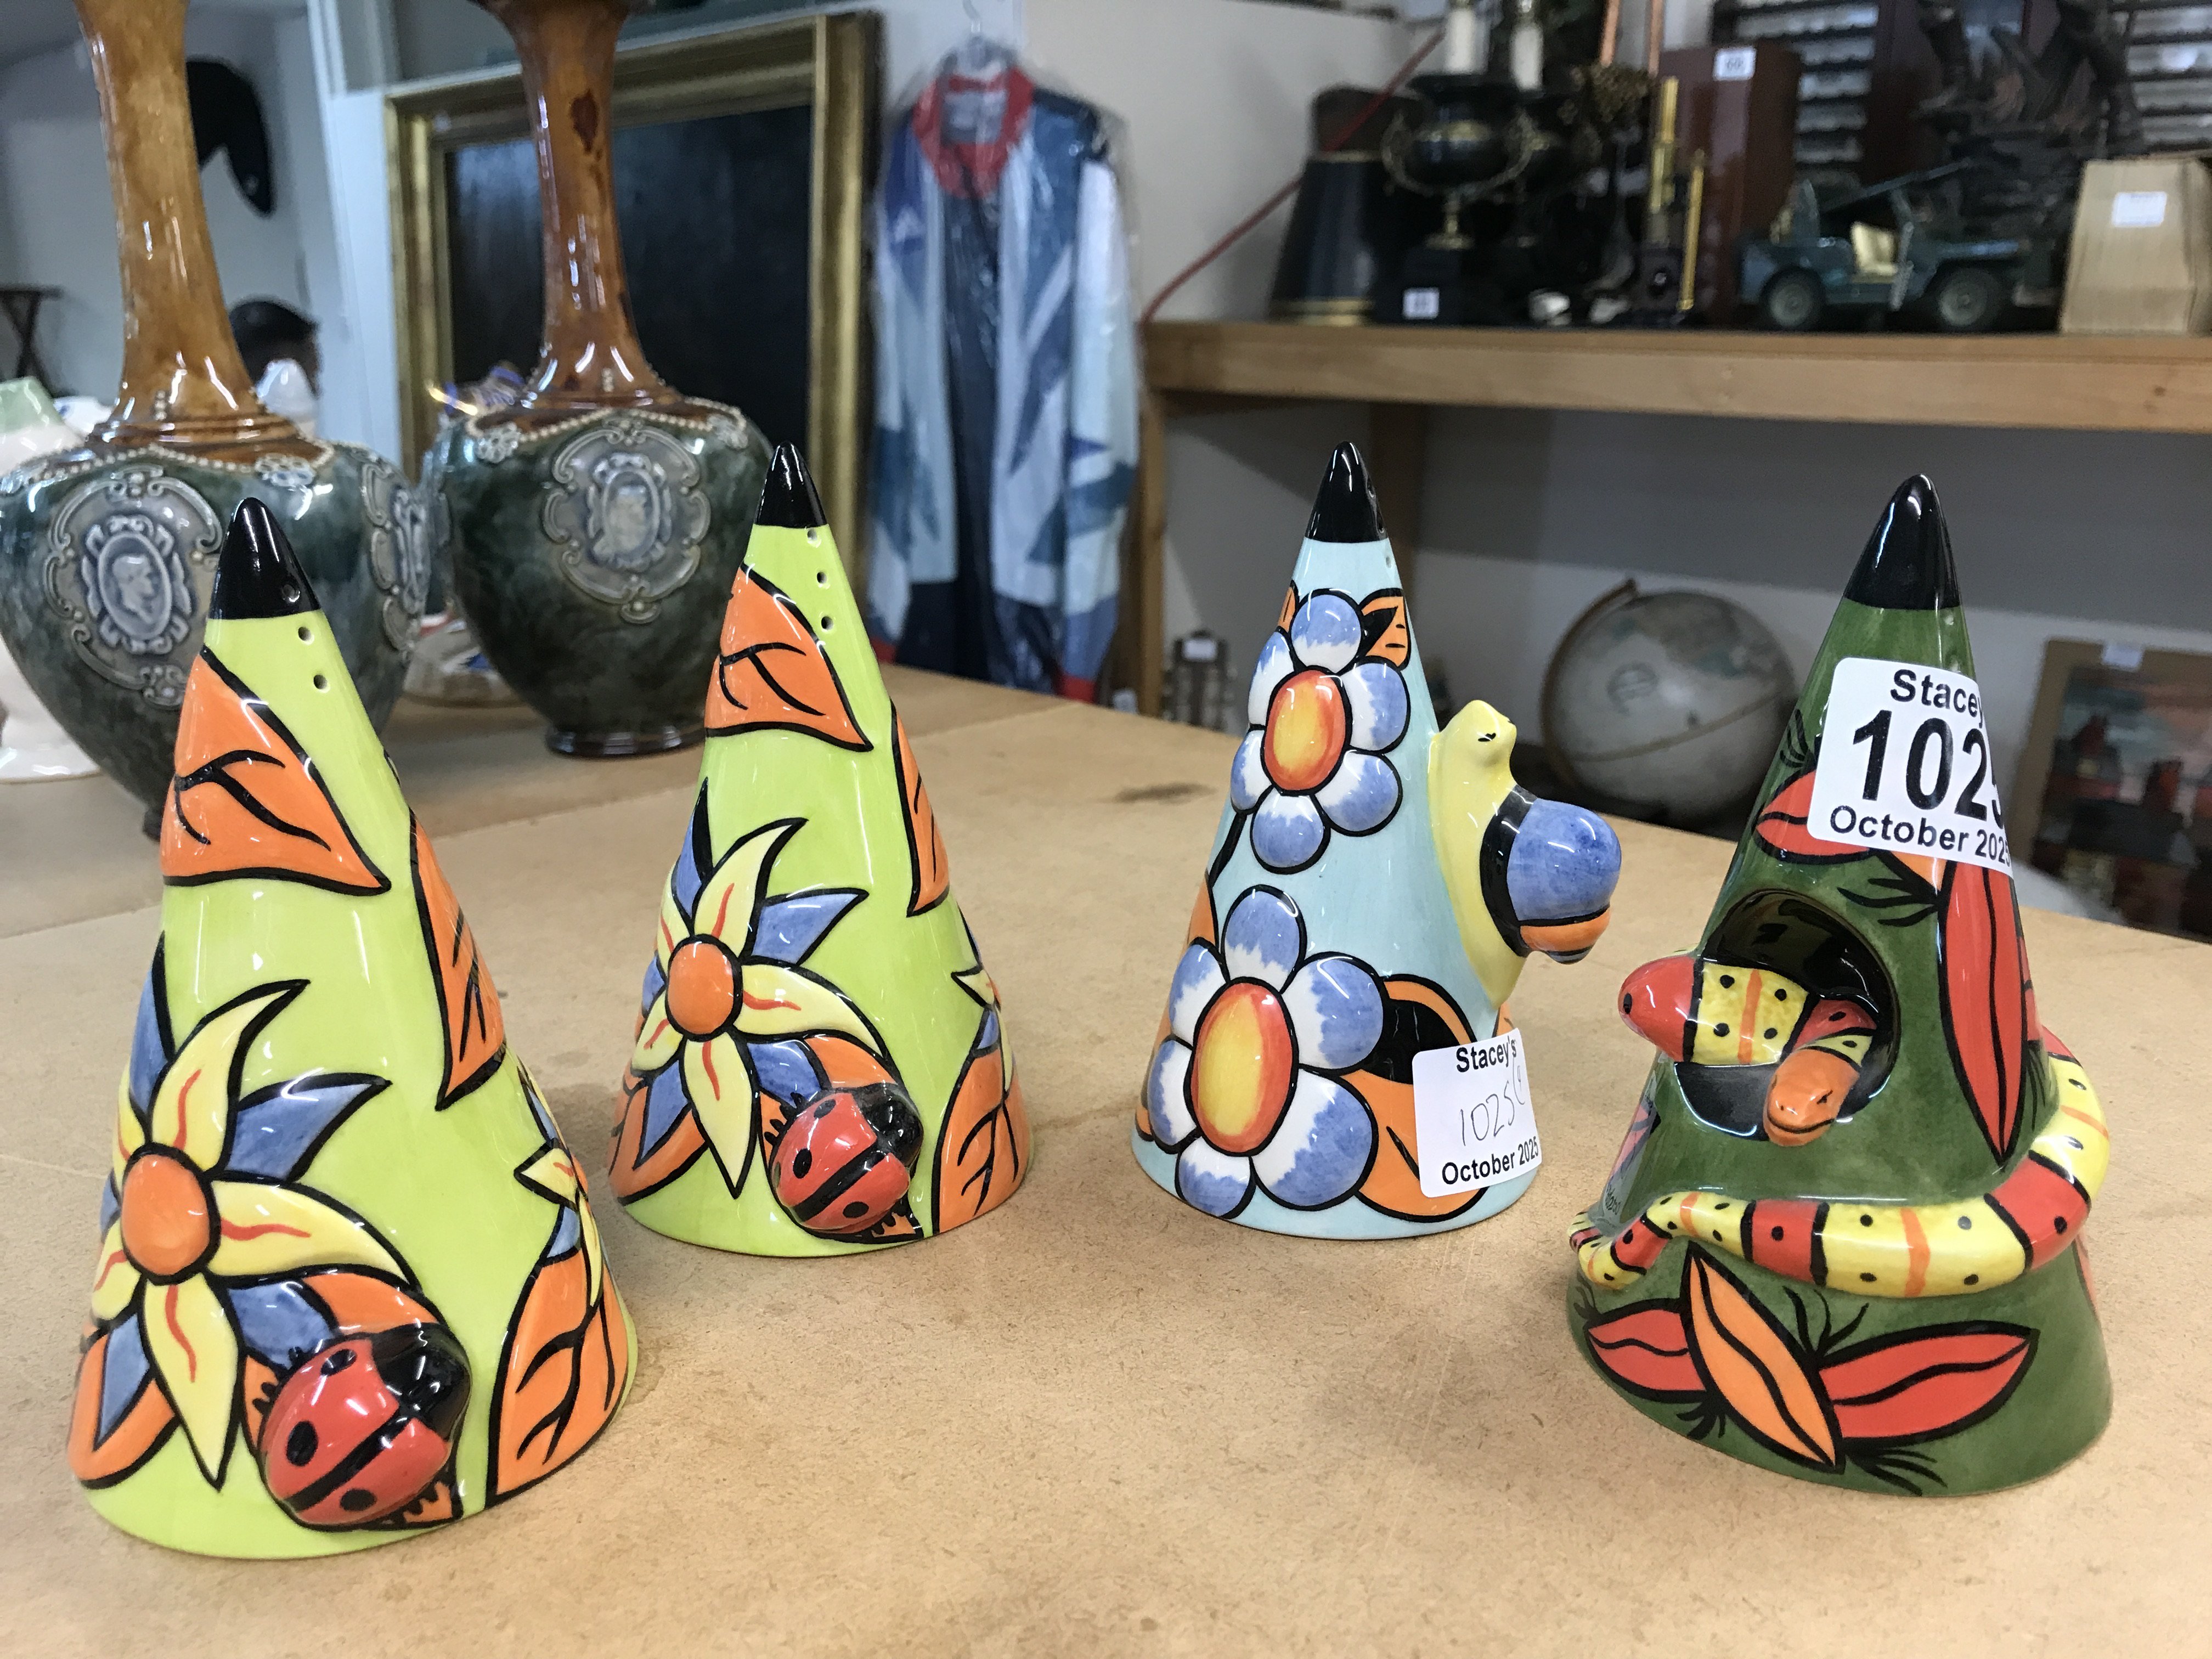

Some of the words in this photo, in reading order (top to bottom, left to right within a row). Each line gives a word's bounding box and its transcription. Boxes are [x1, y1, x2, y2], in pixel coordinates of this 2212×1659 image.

[1830, 805, 1968, 851] October
[1456, 1035, 1516, 1073] Stacey's
[1442, 1151, 1515, 1185] October
[1518, 1136, 1539, 1166] 2025
